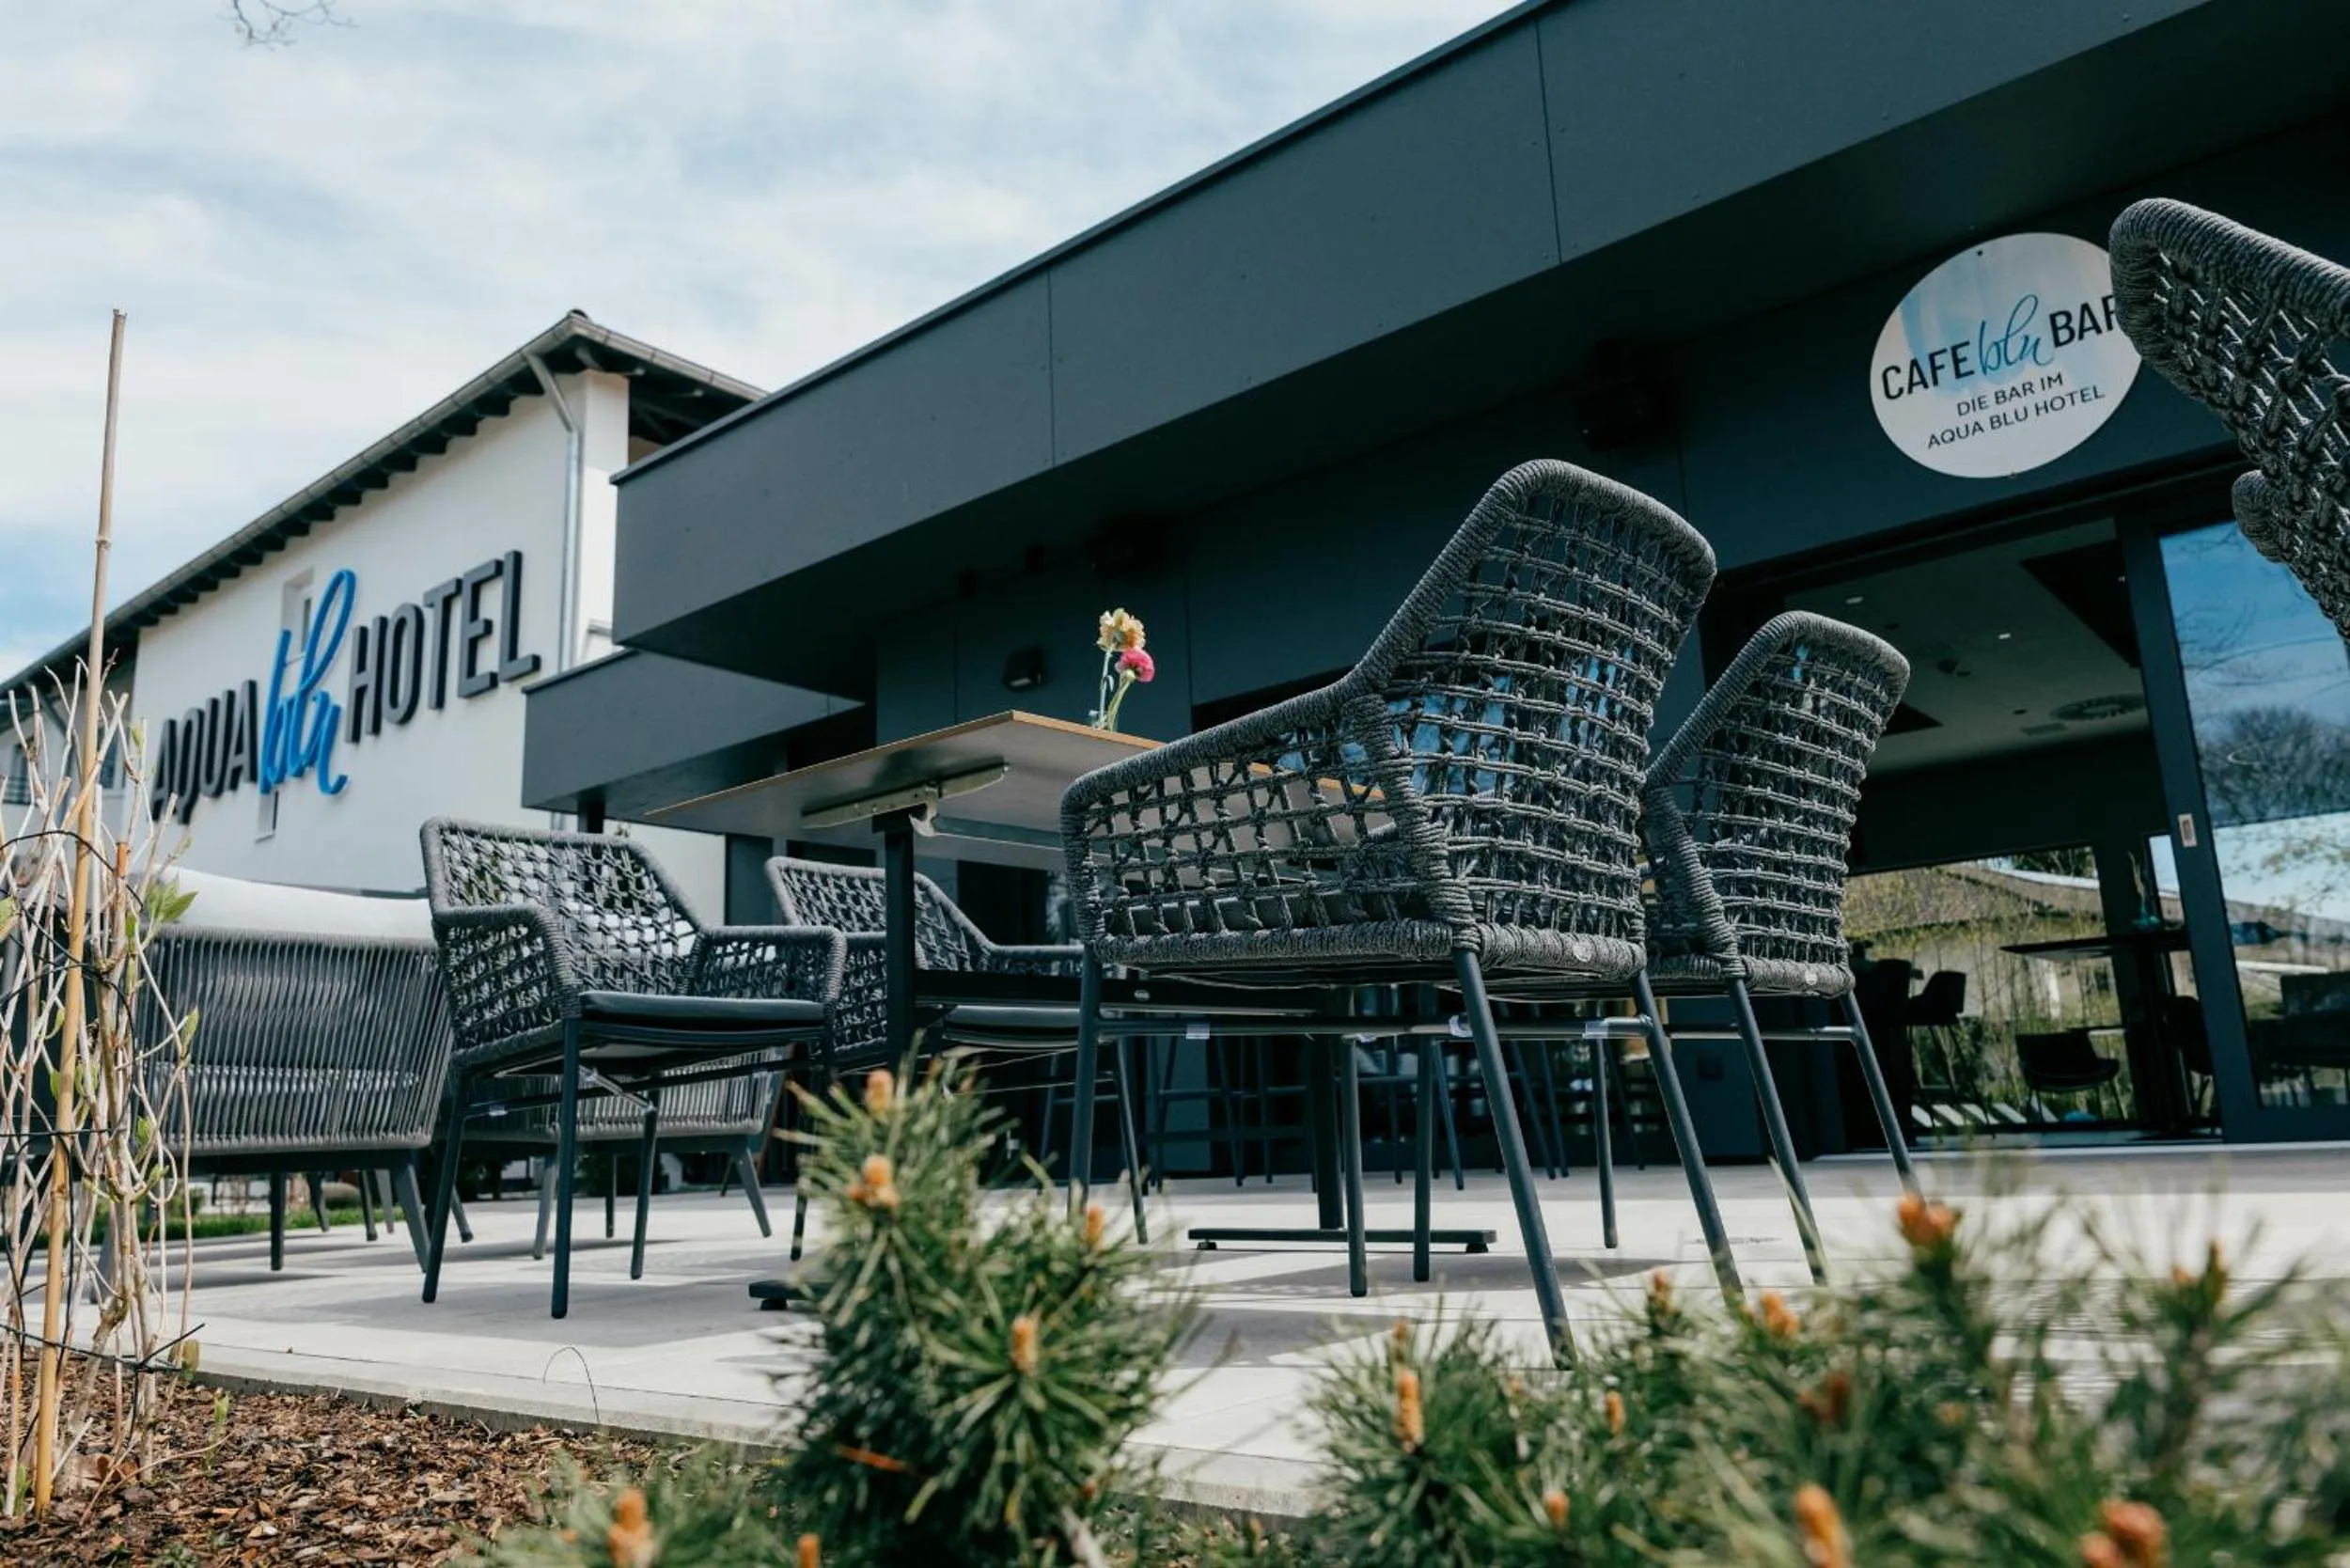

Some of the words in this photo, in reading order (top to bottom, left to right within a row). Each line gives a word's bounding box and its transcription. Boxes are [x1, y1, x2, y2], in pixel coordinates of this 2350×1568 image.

[1881, 341, 1974, 400] CAFE
[1979, 294, 2052, 375] blu
[1927, 421, 1984, 448] AQUA
[1990, 406, 2029, 430] BLU
[2035, 384, 2105, 416] HOTEL
[1957, 398, 1990, 416] DIE
[1995, 381, 2035, 405] BAR
[2041, 373, 2063, 391] IM
[151, 680, 258, 824] AQUA
[259, 569, 356, 795] blu
[346, 550, 541, 744] HOTEL
